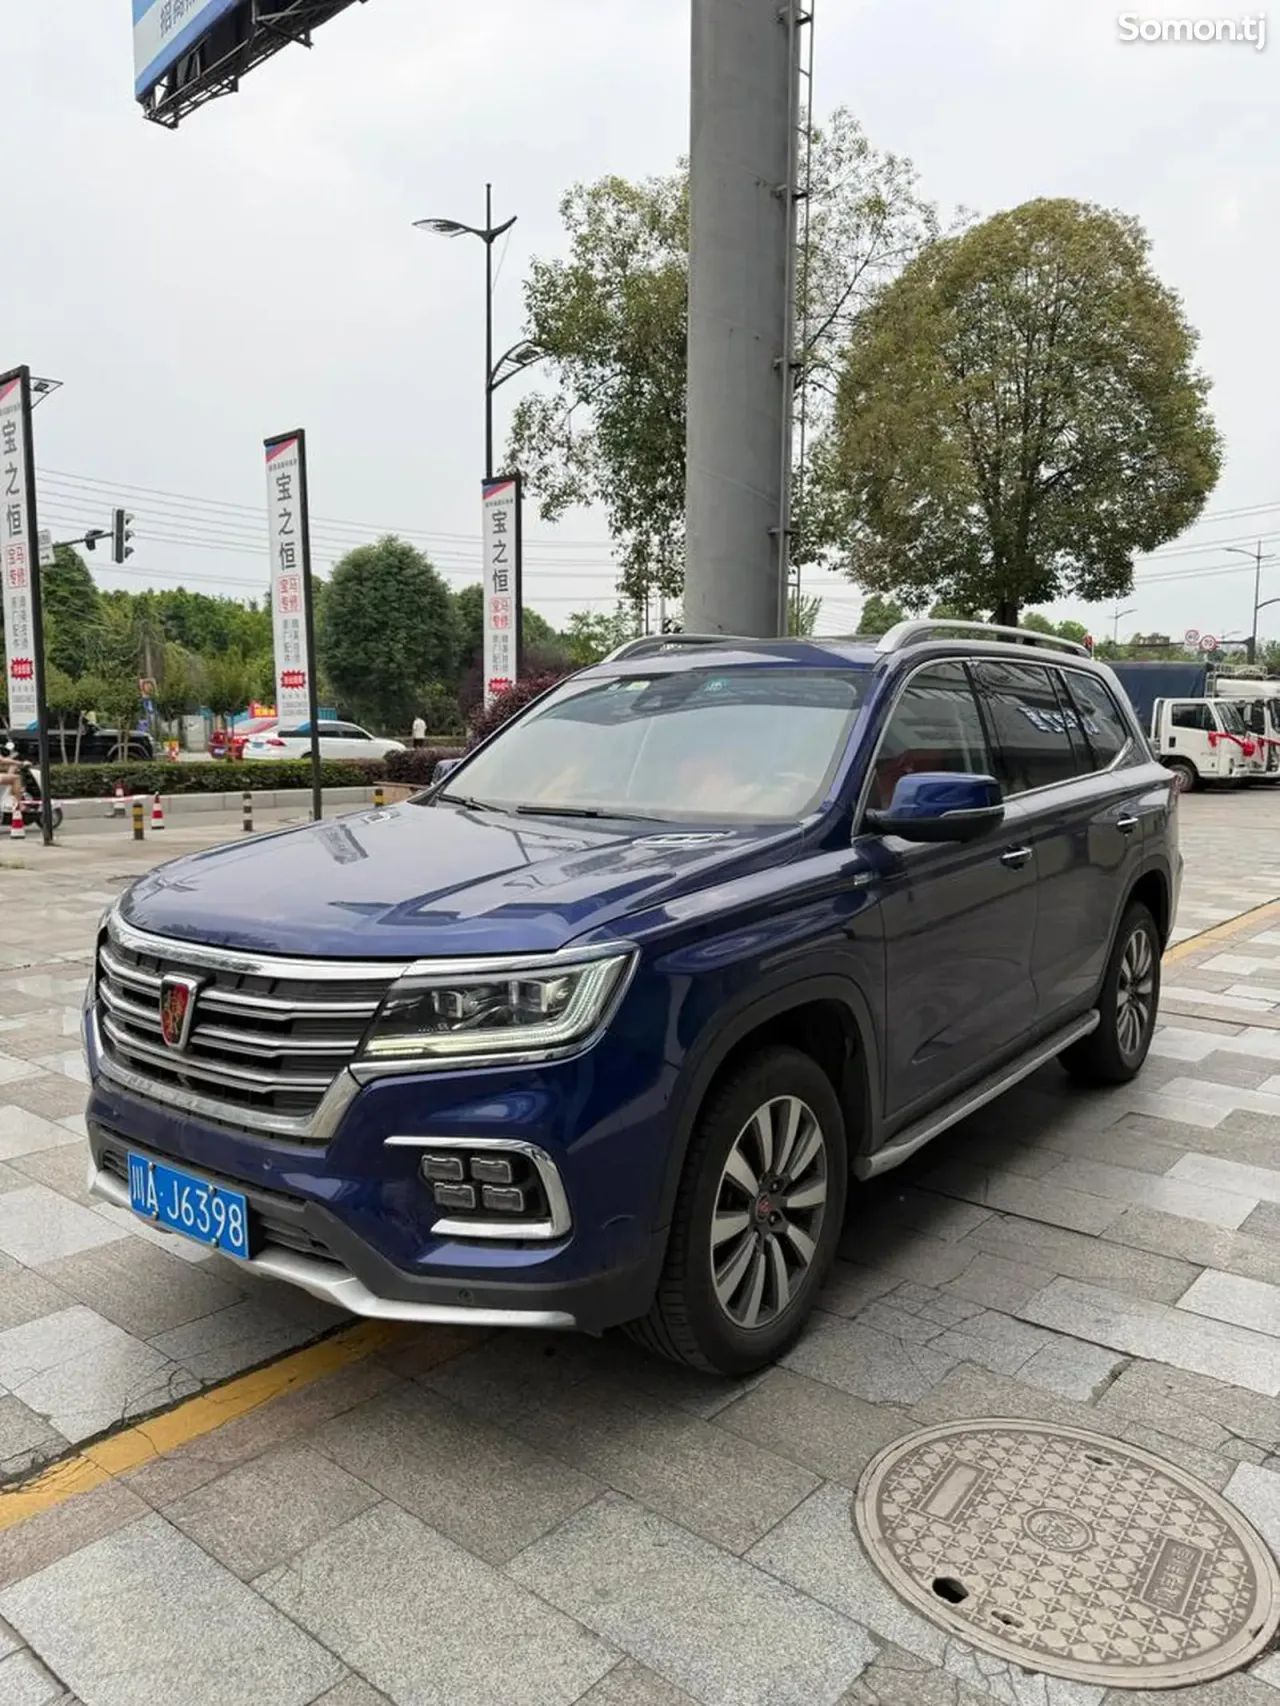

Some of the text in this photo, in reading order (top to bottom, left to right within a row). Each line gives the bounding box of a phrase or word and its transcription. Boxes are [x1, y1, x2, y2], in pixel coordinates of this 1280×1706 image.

[2, 419, 23, 538] 宝之恒
[276, 472, 297, 571] 宝之恒
[491, 509, 509, 594] 宝之恒
